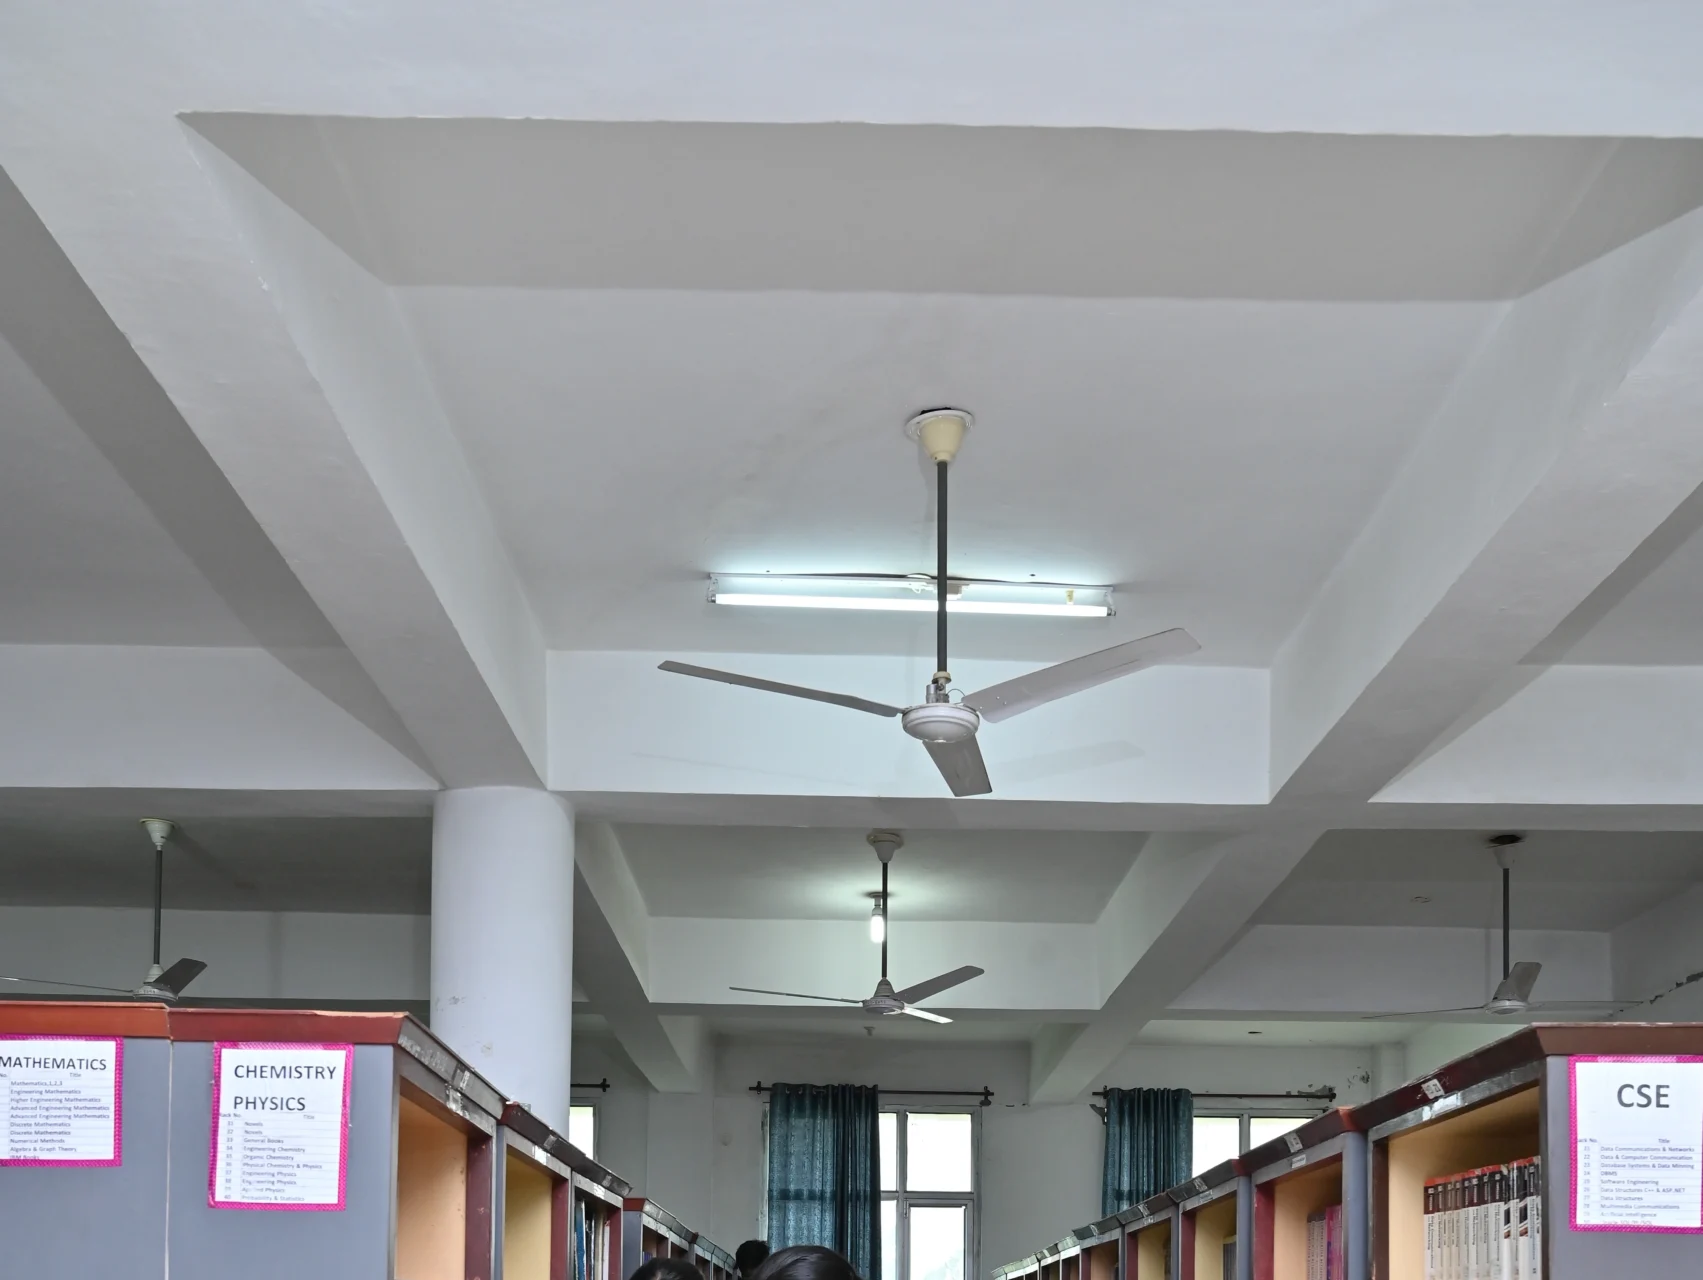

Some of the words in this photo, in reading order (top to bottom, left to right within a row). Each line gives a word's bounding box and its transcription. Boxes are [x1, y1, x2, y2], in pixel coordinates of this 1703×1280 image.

[0, 1056, 107, 1070] MATHEMATICS
[234, 1065, 337, 1079] CHEMISTRY
[1617, 1084, 1670, 1108] CSE
[234, 1096, 306, 1111] PHYSICS
